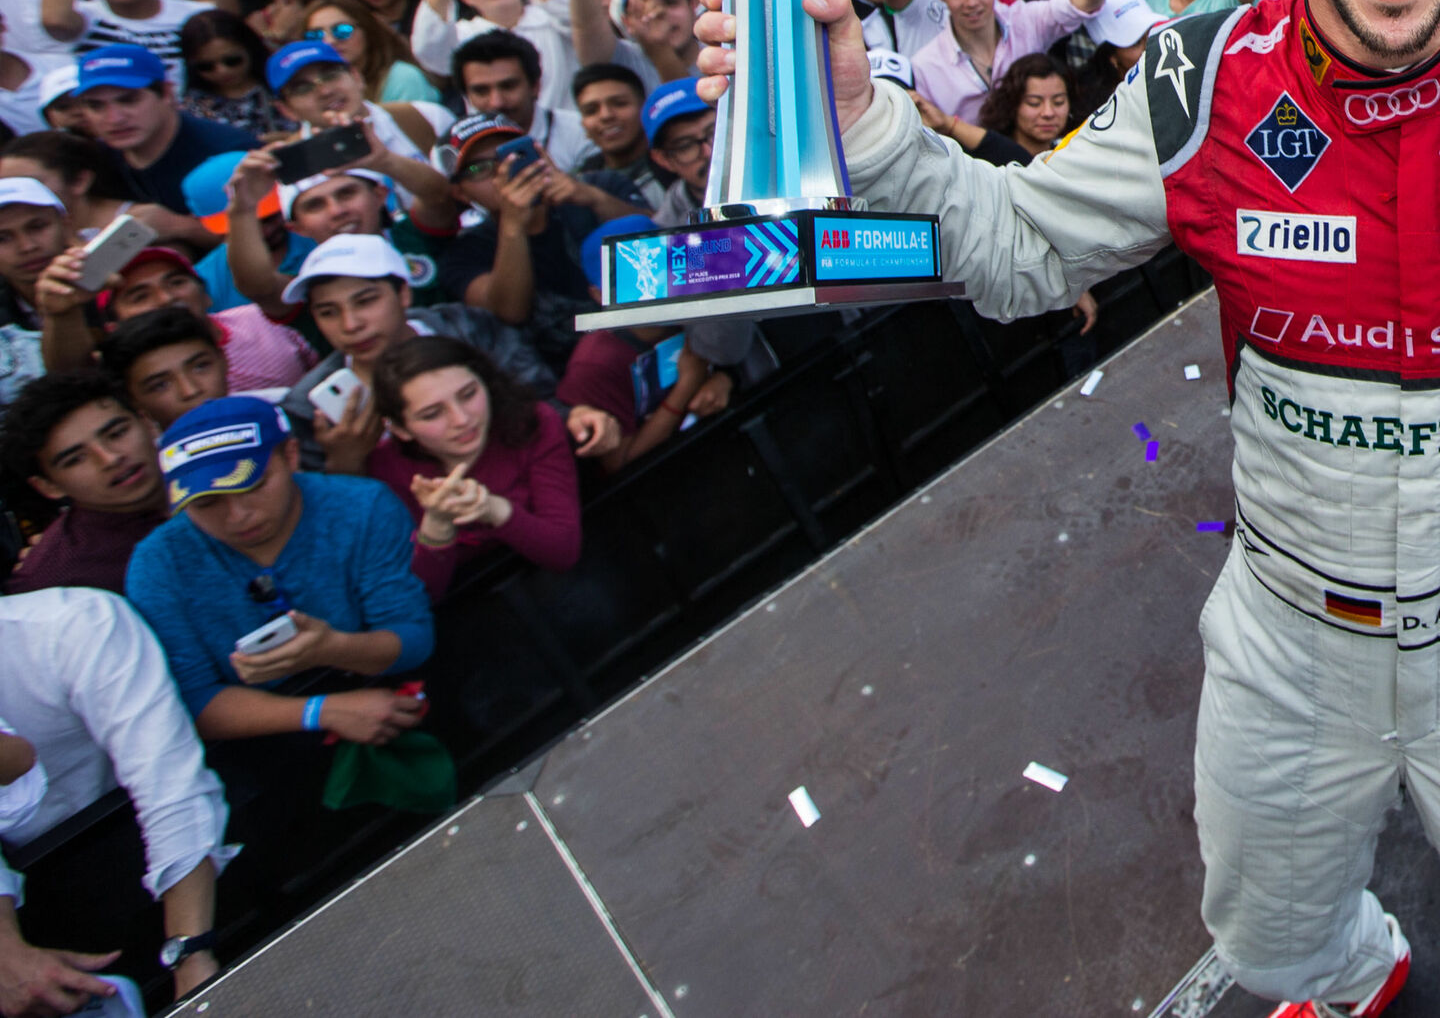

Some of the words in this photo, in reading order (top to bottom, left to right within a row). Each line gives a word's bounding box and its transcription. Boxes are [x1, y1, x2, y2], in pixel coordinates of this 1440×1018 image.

[1258, 128, 1319, 159] LGT
[821, 230, 850, 249] ABB
[1267, 218, 1351, 254] riello
[672, 245, 687, 286] MEX
[1302, 314, 1413, 358] Audi
[1402, 616, 1428, 632] D.
